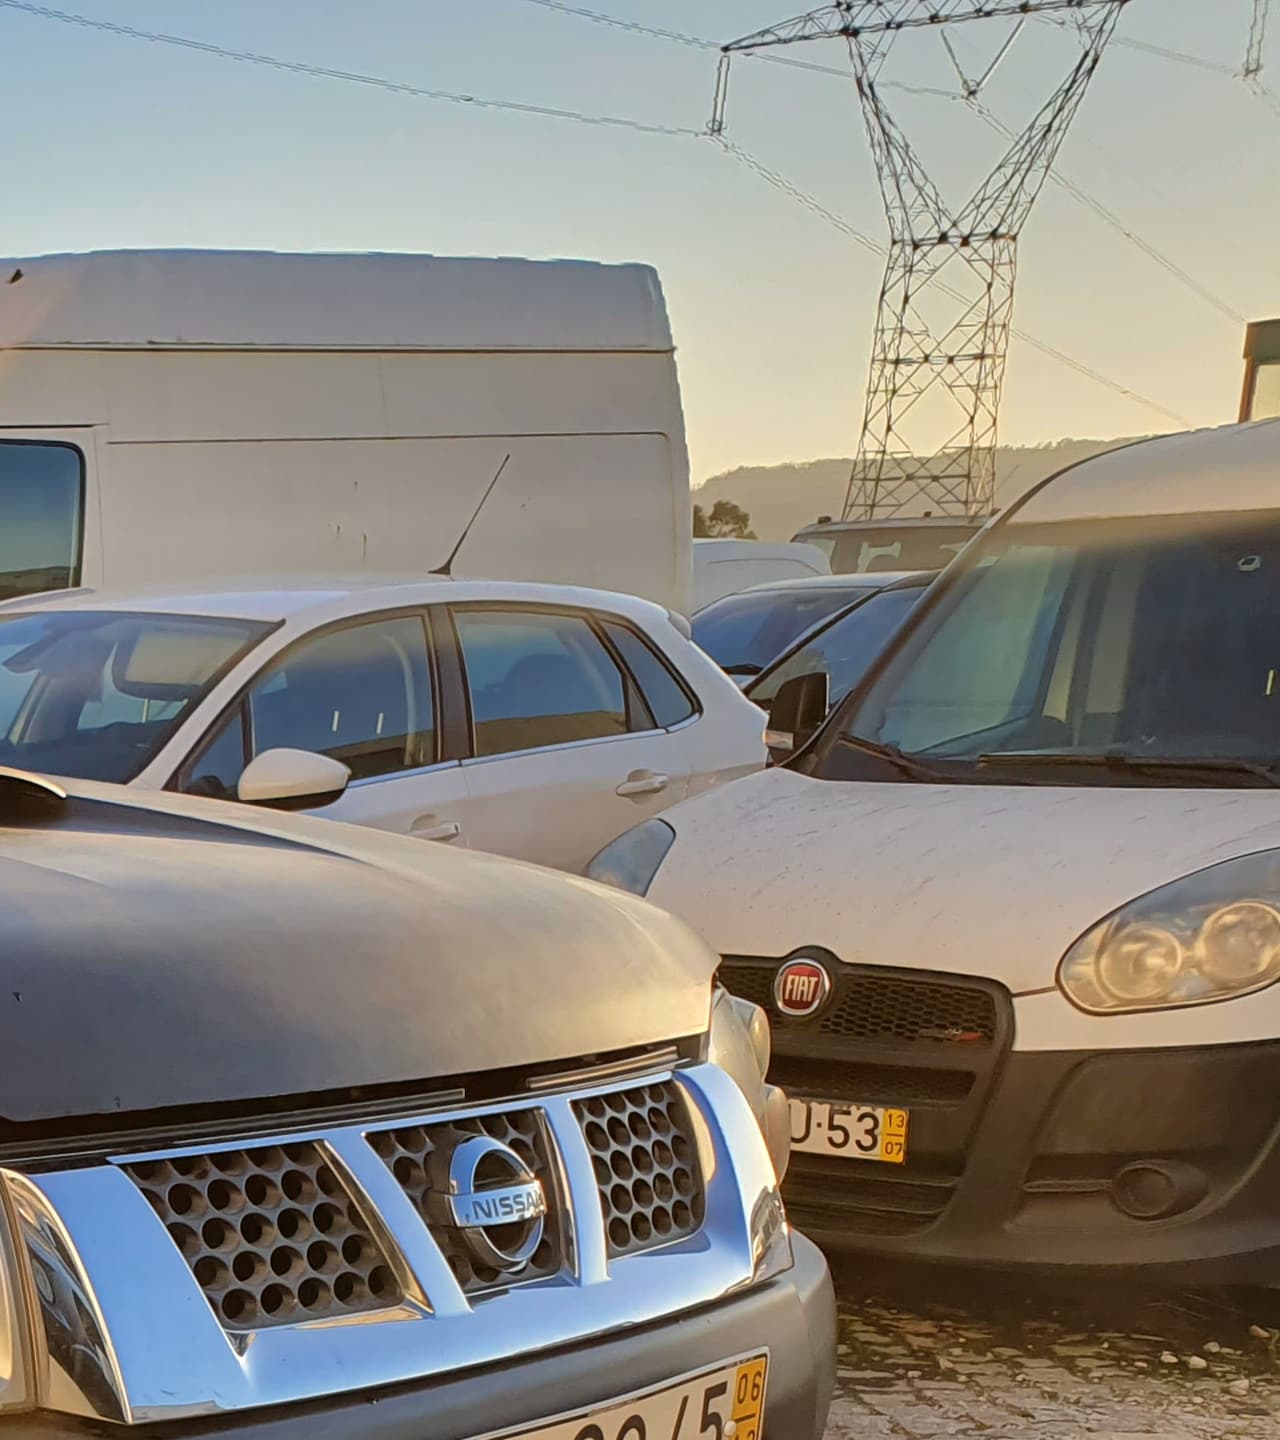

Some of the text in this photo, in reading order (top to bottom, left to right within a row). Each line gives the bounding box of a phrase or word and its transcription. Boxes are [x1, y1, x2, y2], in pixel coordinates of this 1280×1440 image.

[784, 974, 819, 1002] FIAT
[888, 1113, 905, 1129] 13
[885, 1141, 903, 1156] 07
[737, 1371, 762, 1405] 06
